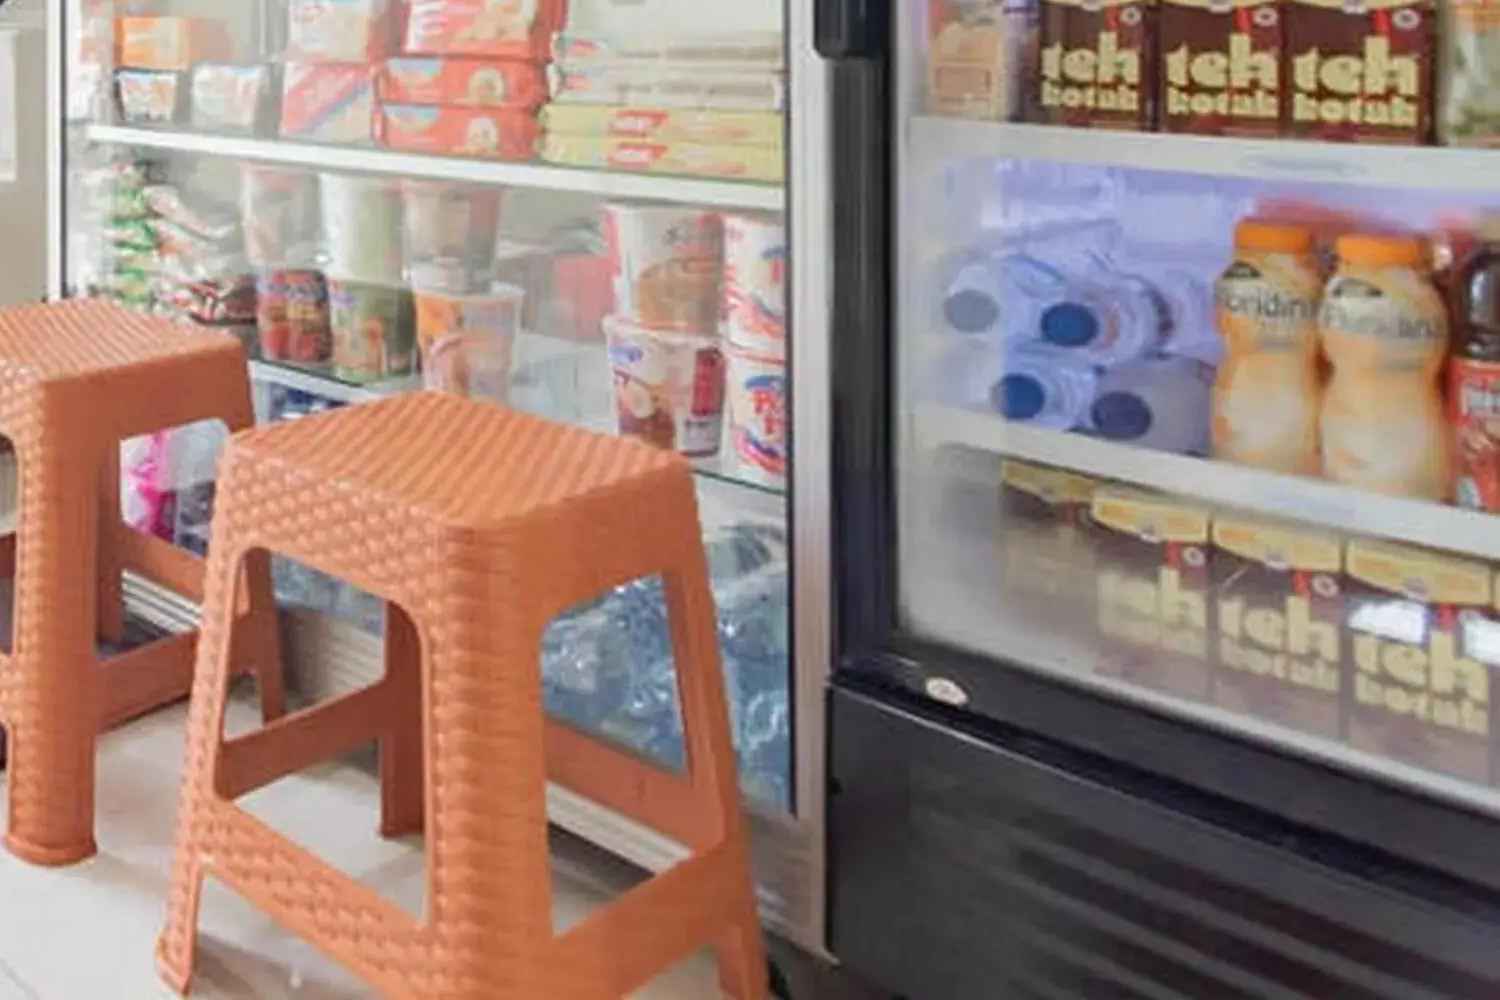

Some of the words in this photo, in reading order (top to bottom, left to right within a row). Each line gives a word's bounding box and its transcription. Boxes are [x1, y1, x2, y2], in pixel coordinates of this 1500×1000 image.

[1041, 31, 1140, 85] teh
[1165, 33, 1278, 90] teh
[1293, 36, 1418, 97] teh
[1218, 595, 1340, 665] teh
[1353, 629, 1490, 708] teh
